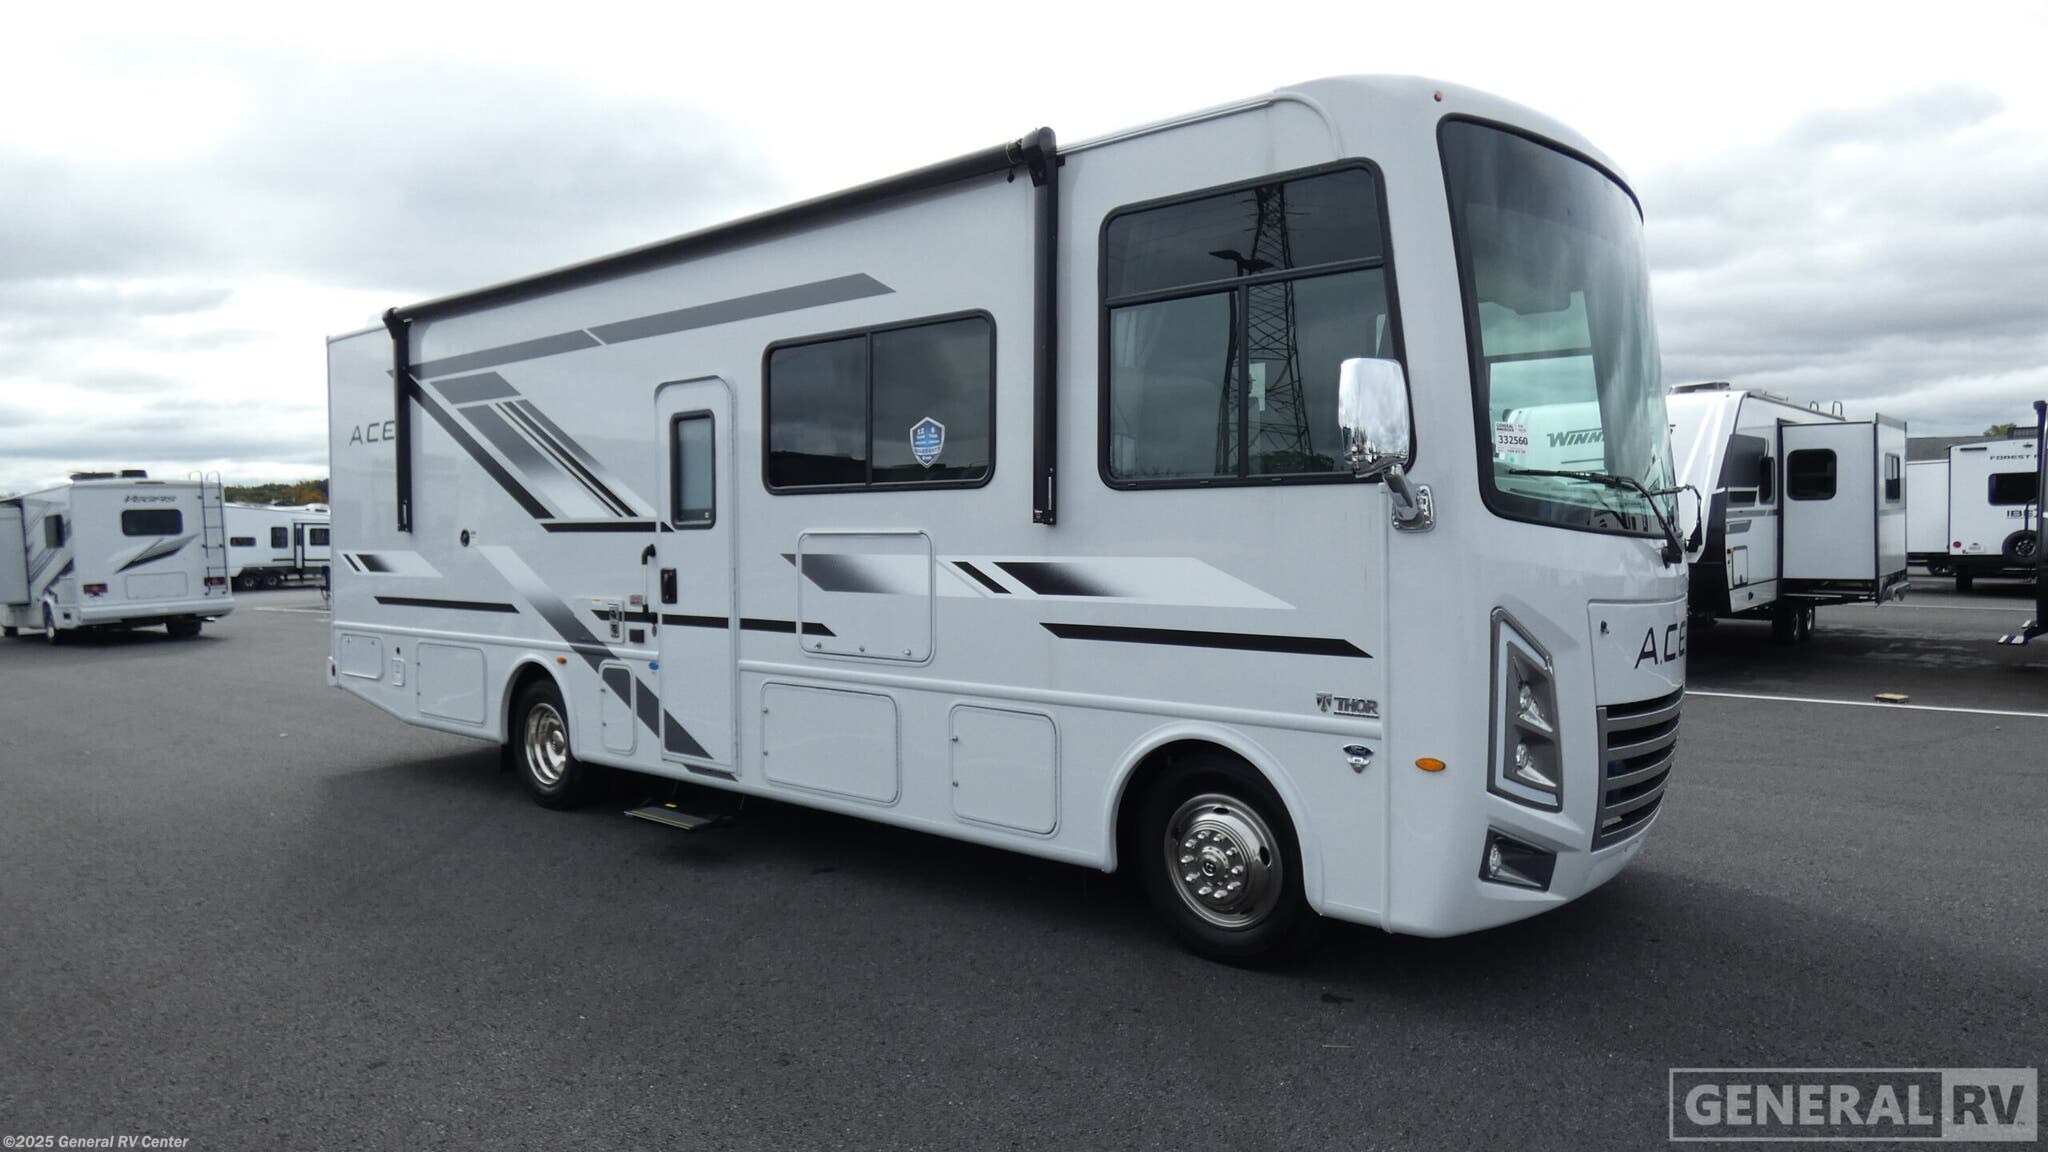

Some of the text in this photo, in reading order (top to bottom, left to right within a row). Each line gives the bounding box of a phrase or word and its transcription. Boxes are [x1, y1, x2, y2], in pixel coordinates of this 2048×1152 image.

[1498, 434, 1528, 446] 332560
[1546, 428, 1603, 448] WINN
[1333, 696, 1379, 715] THOR
